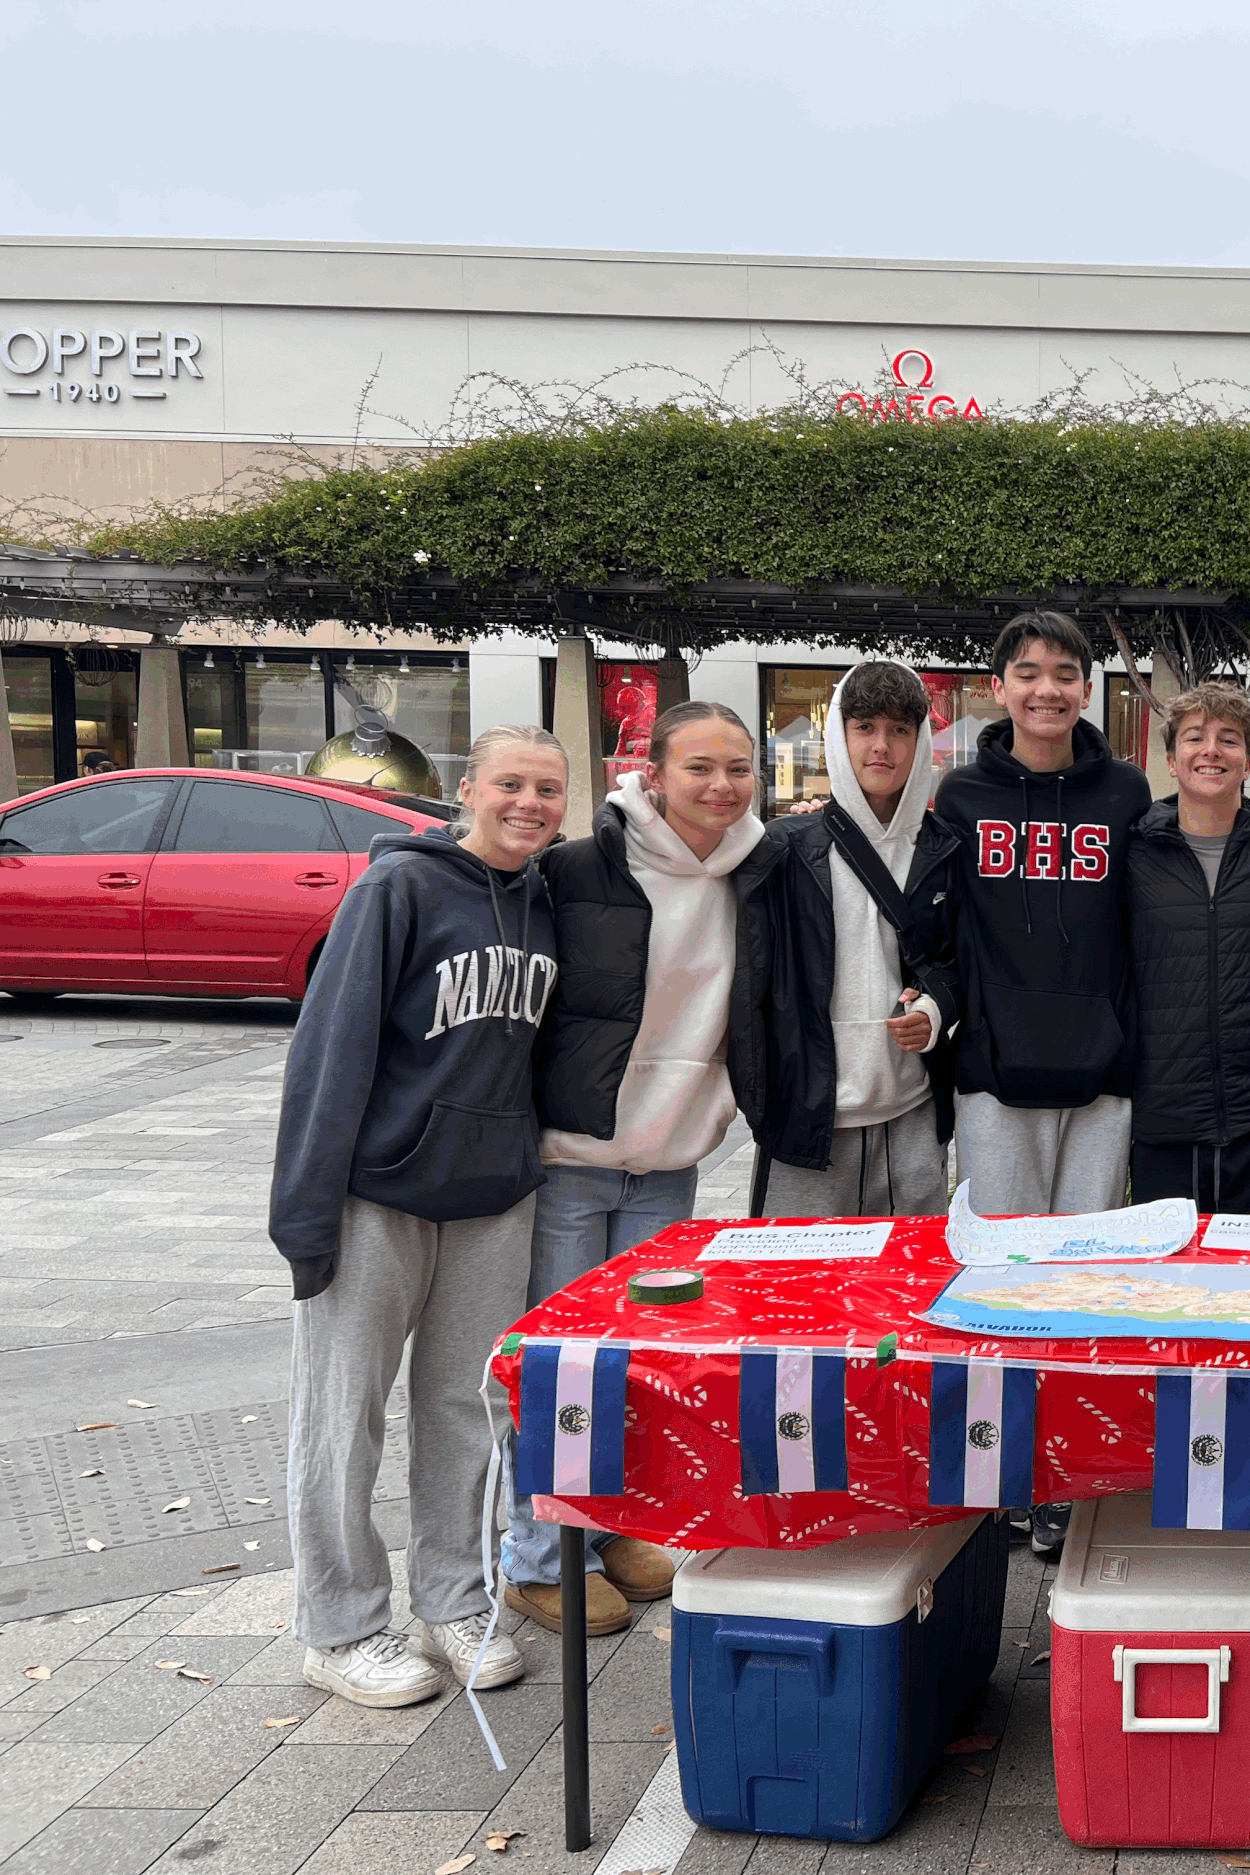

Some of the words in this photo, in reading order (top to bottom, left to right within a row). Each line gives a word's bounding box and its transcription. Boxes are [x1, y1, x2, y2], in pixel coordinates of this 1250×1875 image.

[0, 326, 204, 378] OPPER
[50, 381, 120, 403] 1940
[976, 819, 1110, 882] BHS
[786, 1229, 876, 1239] Chapter
